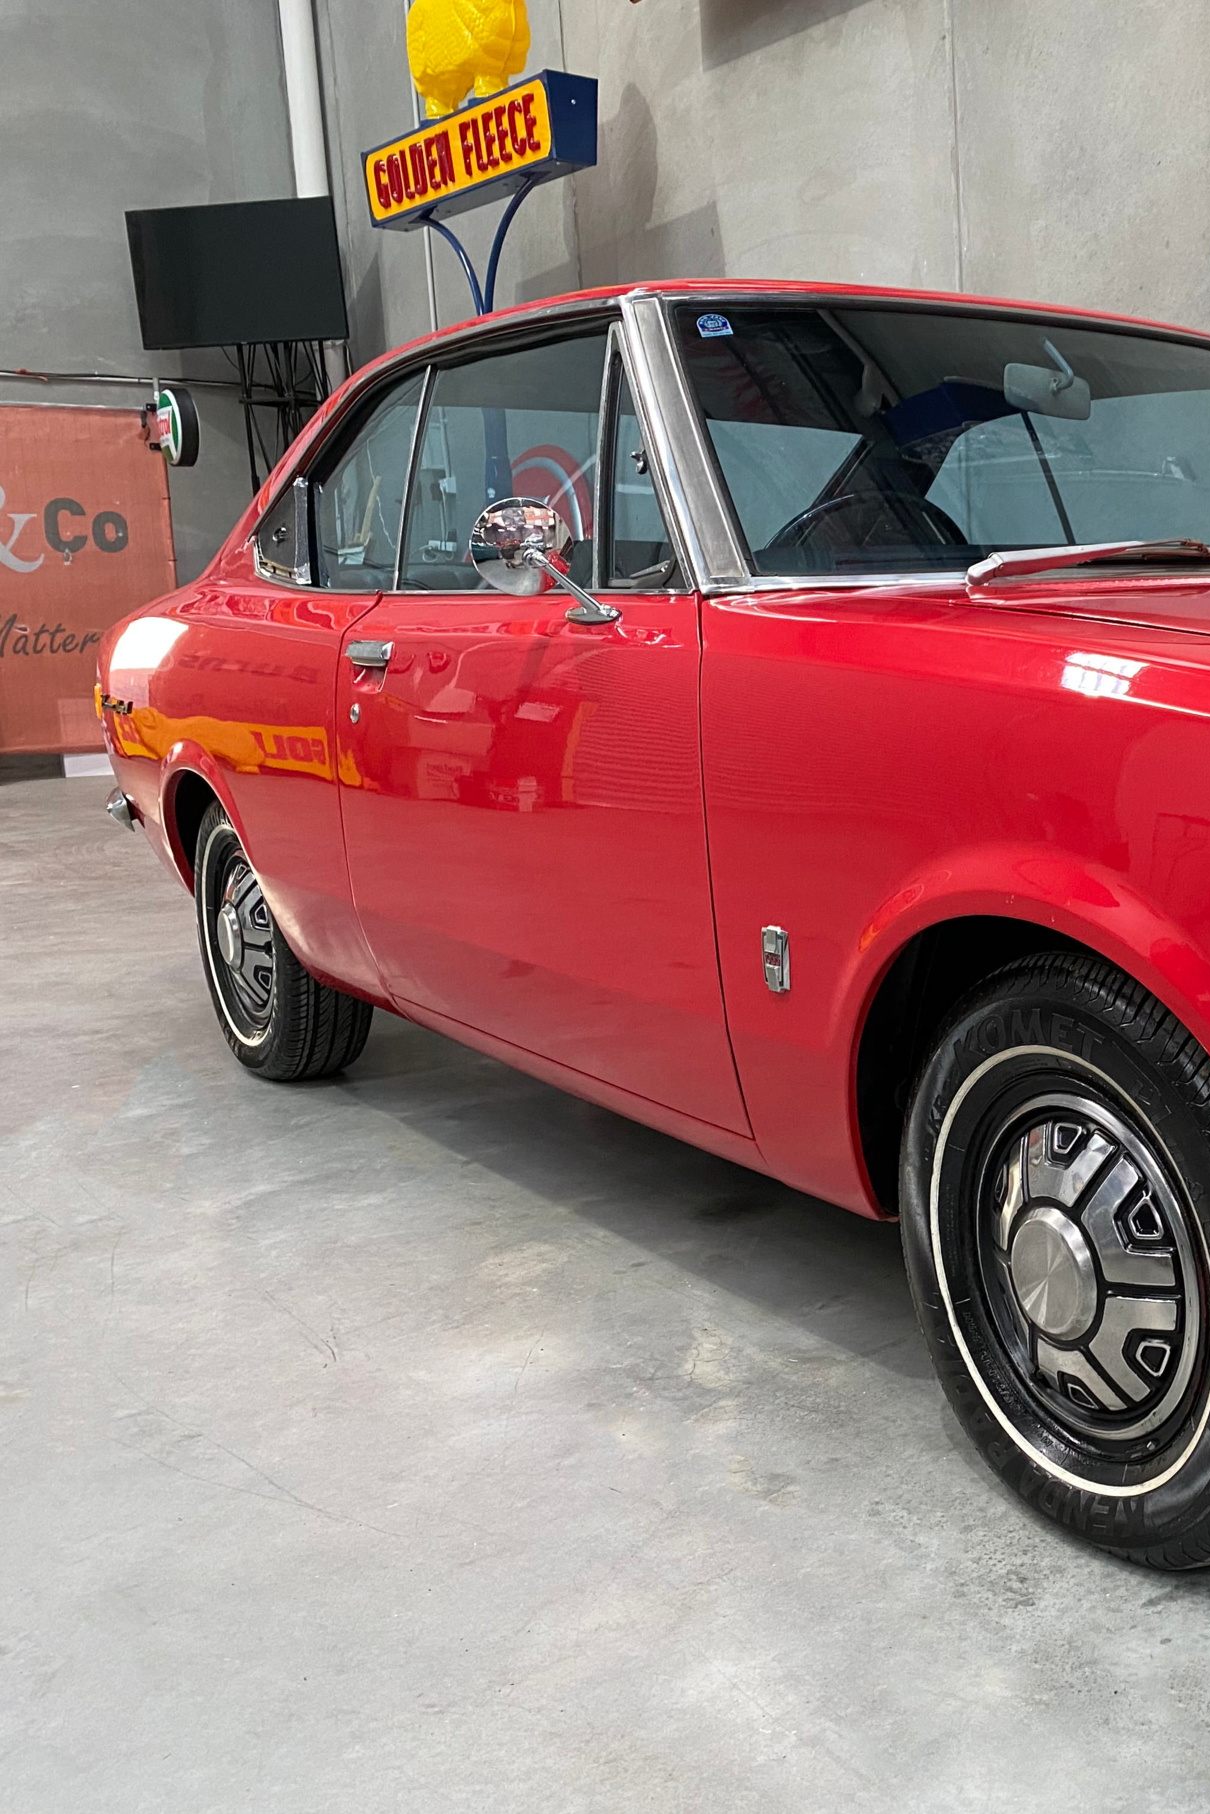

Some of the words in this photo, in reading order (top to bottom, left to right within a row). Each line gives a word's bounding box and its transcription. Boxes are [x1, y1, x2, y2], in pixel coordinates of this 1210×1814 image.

[374, 130, 455, 209] GOLDEN
[459, 93, 541, 177] FLEECE
[953, 1008, 1105, 1073] KOMET
[1018, 1461, 1150, 1537] KENDA
